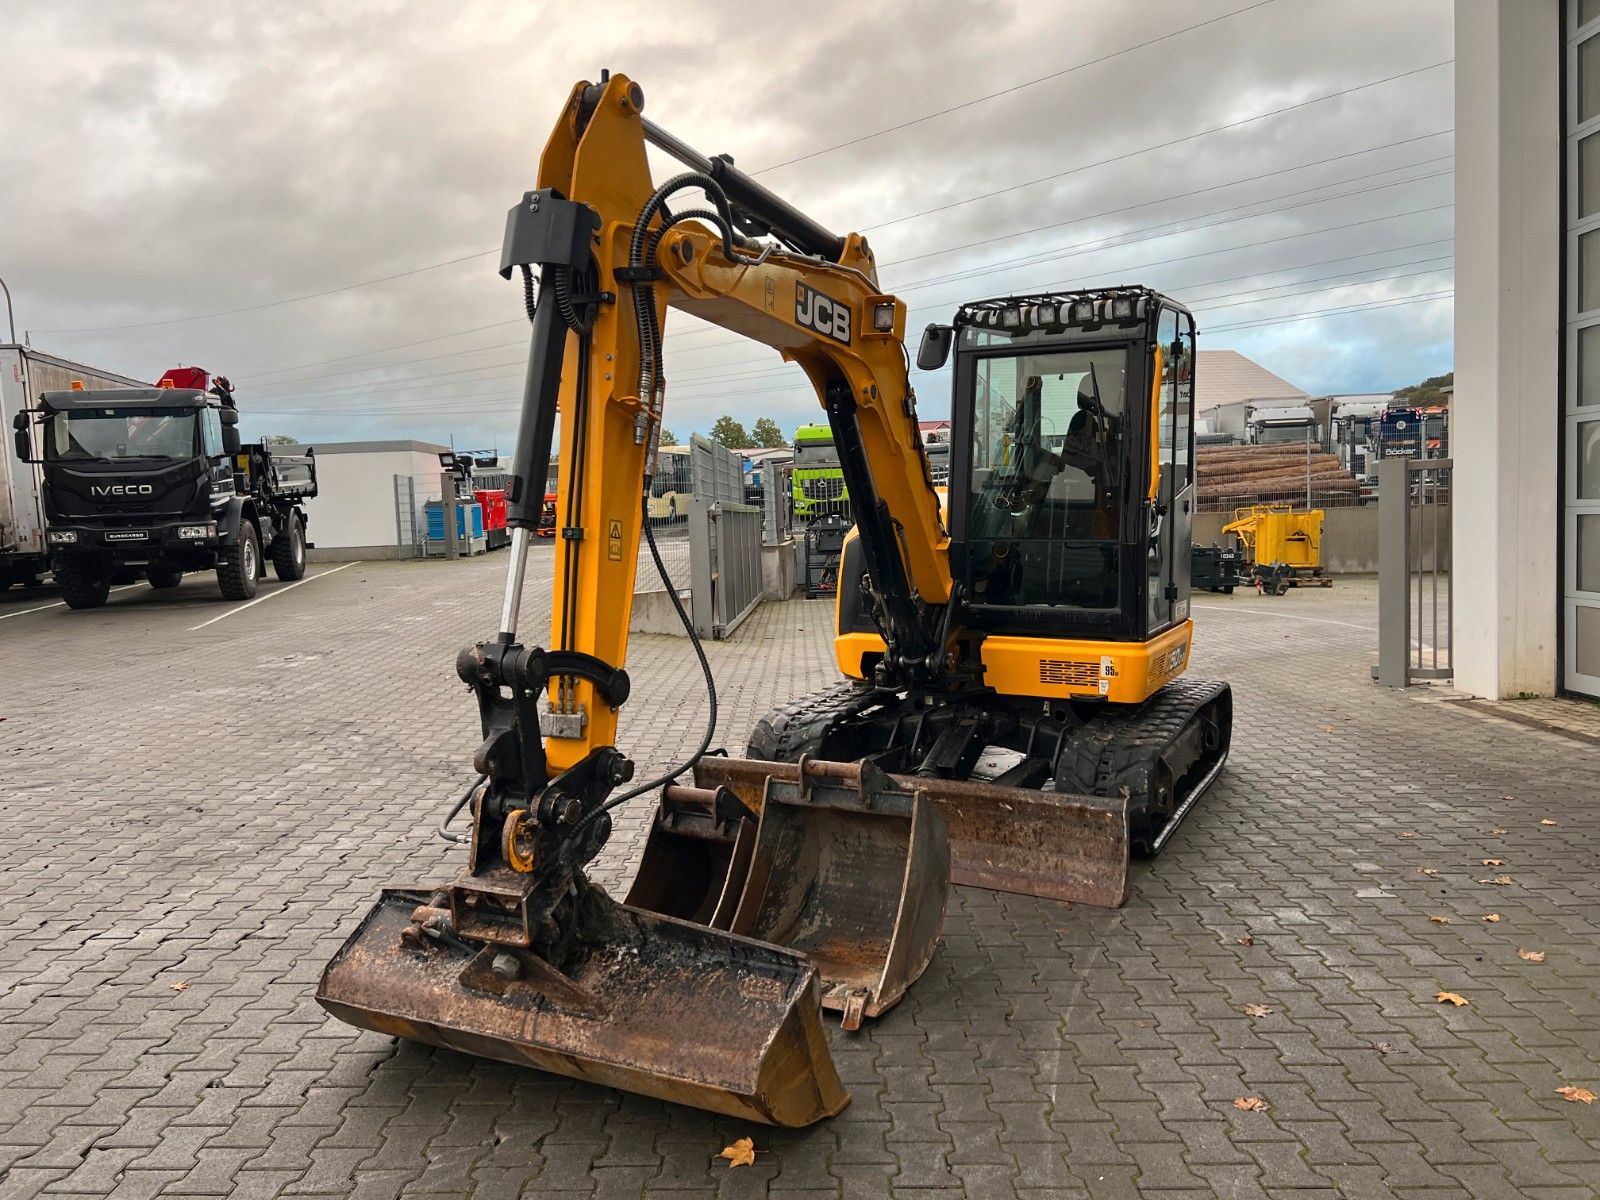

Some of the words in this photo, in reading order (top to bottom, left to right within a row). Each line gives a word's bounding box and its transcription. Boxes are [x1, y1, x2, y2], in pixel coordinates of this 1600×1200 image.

[796, 289, 850, 344] JCB
[91, 485, 152, 496] IVECO
[1105, 665, 1115, 676] 95
